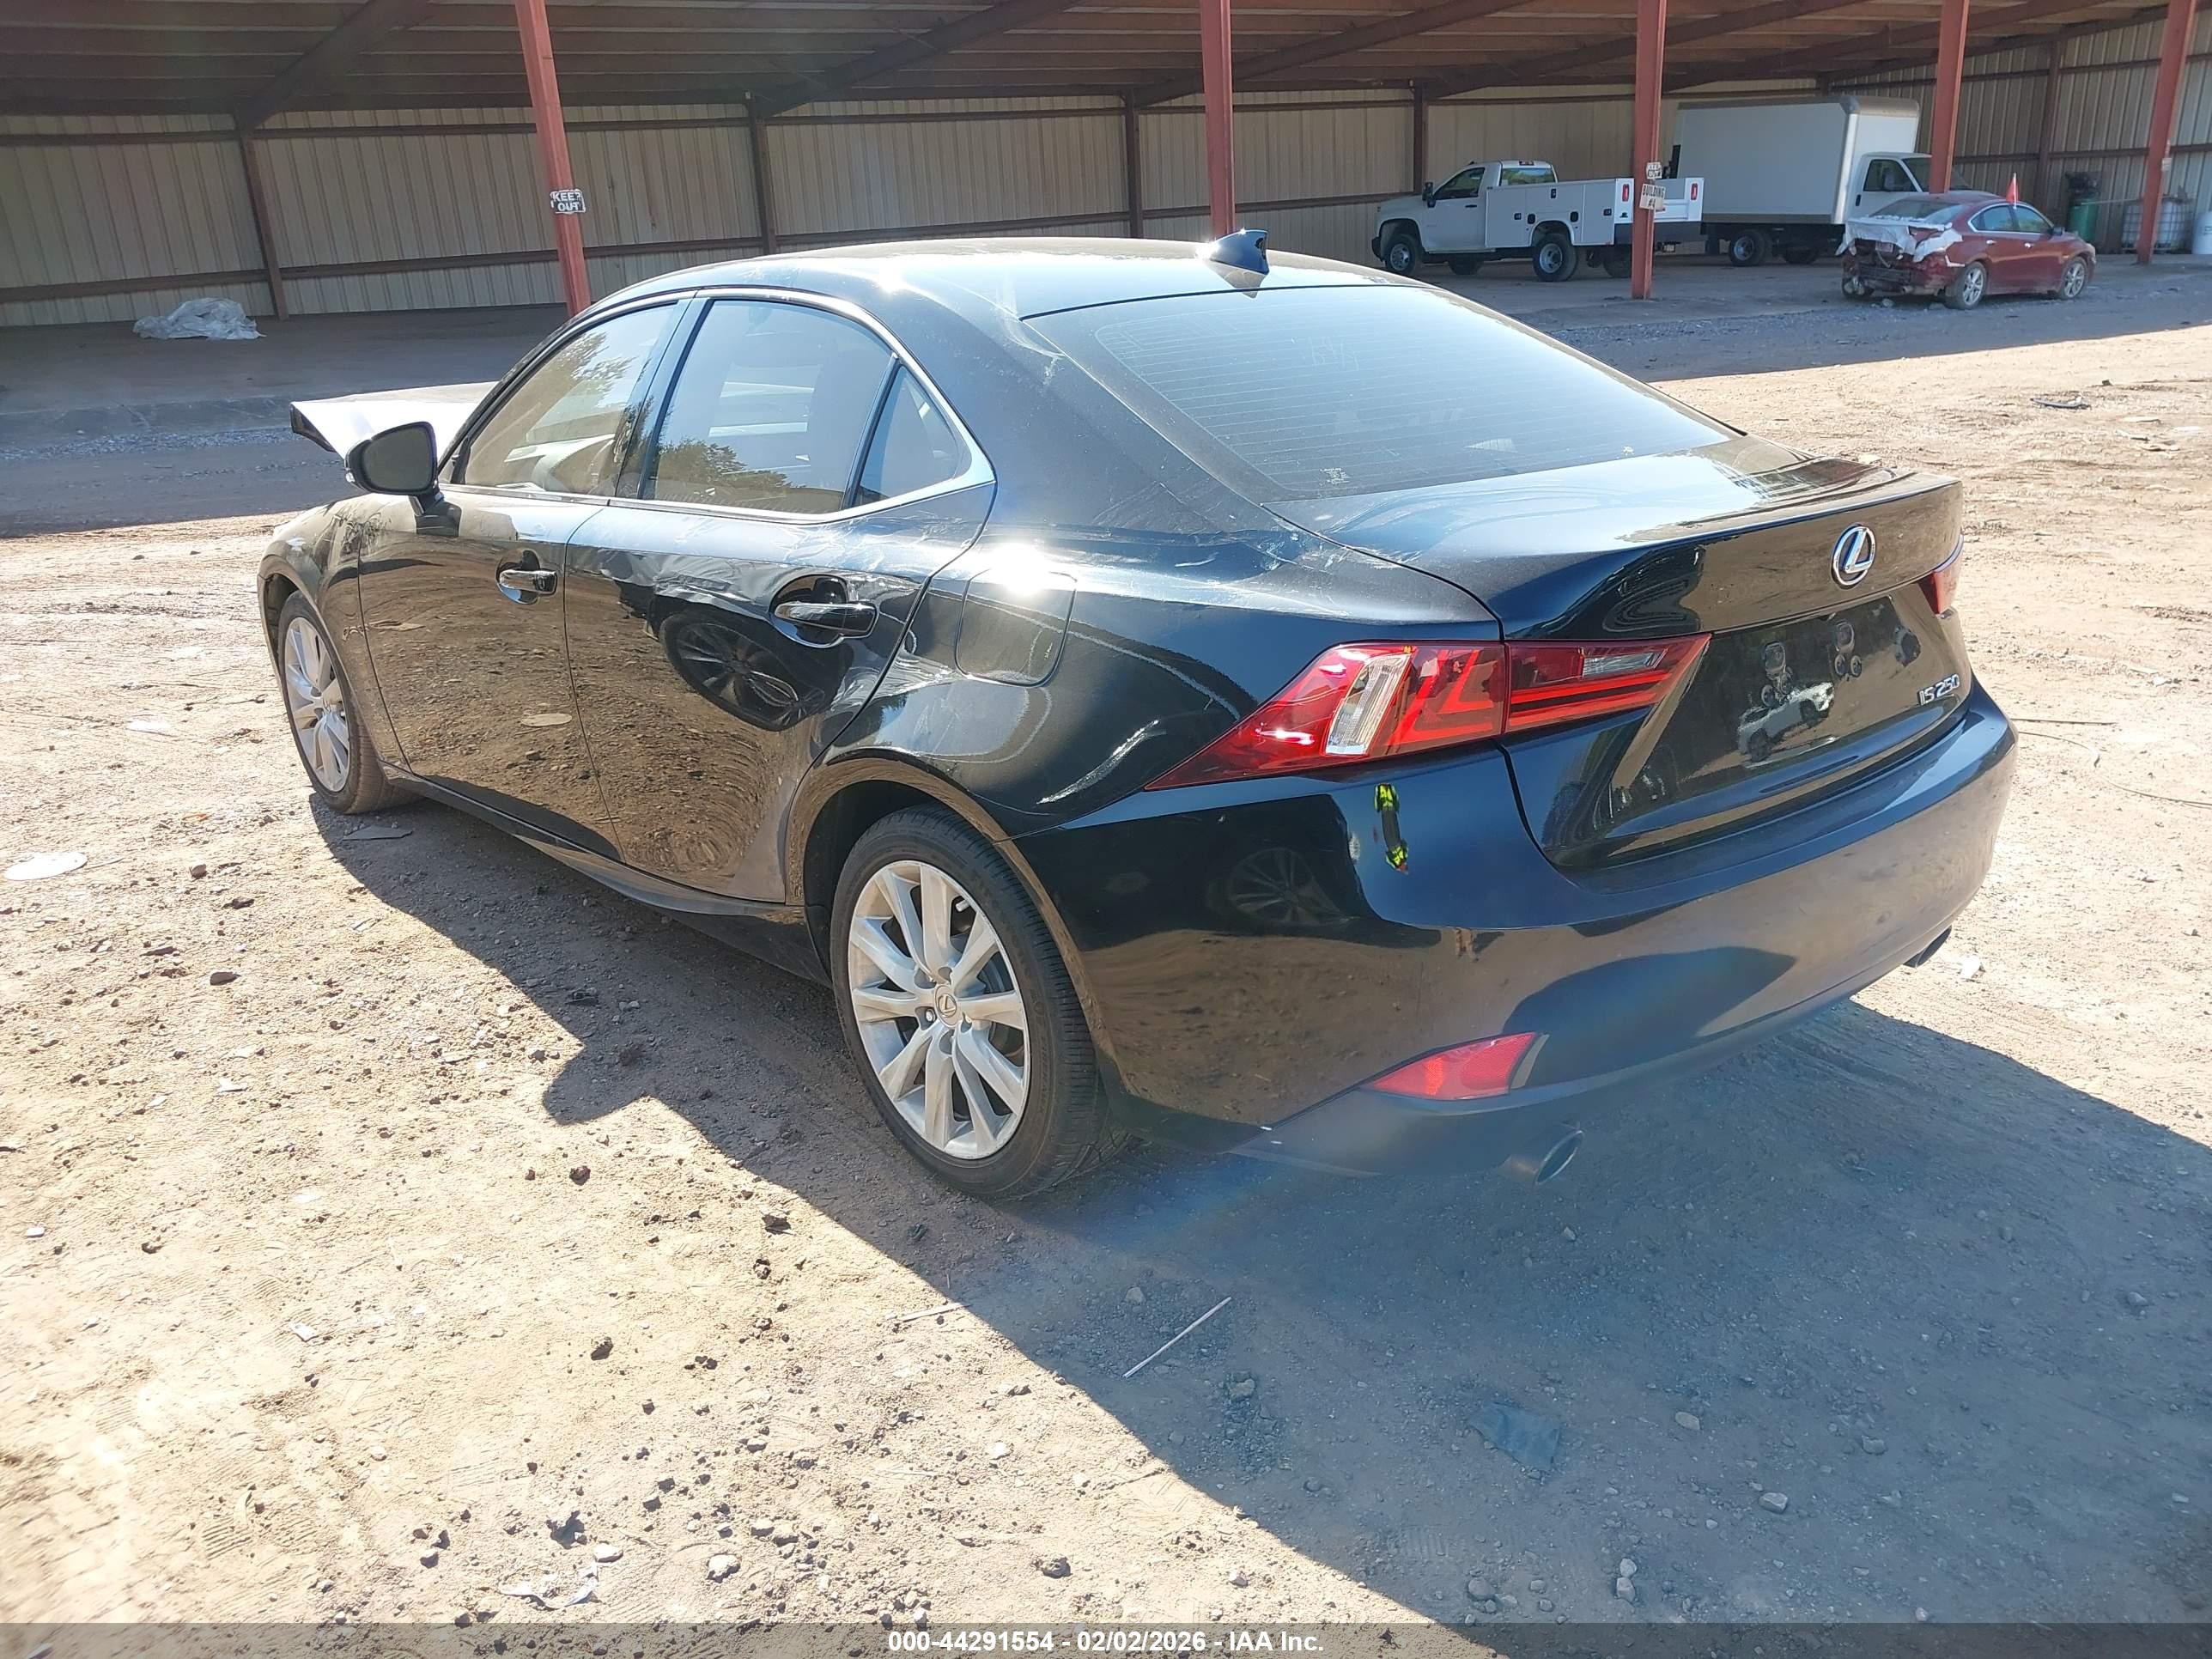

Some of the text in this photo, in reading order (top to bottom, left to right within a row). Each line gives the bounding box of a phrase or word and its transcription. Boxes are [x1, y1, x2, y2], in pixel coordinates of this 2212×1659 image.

[1642, 185, 1665, 198] BUILDING
[557, 203, 580, 211] OUT
[1919, 673, 1960, 706] IS 250
